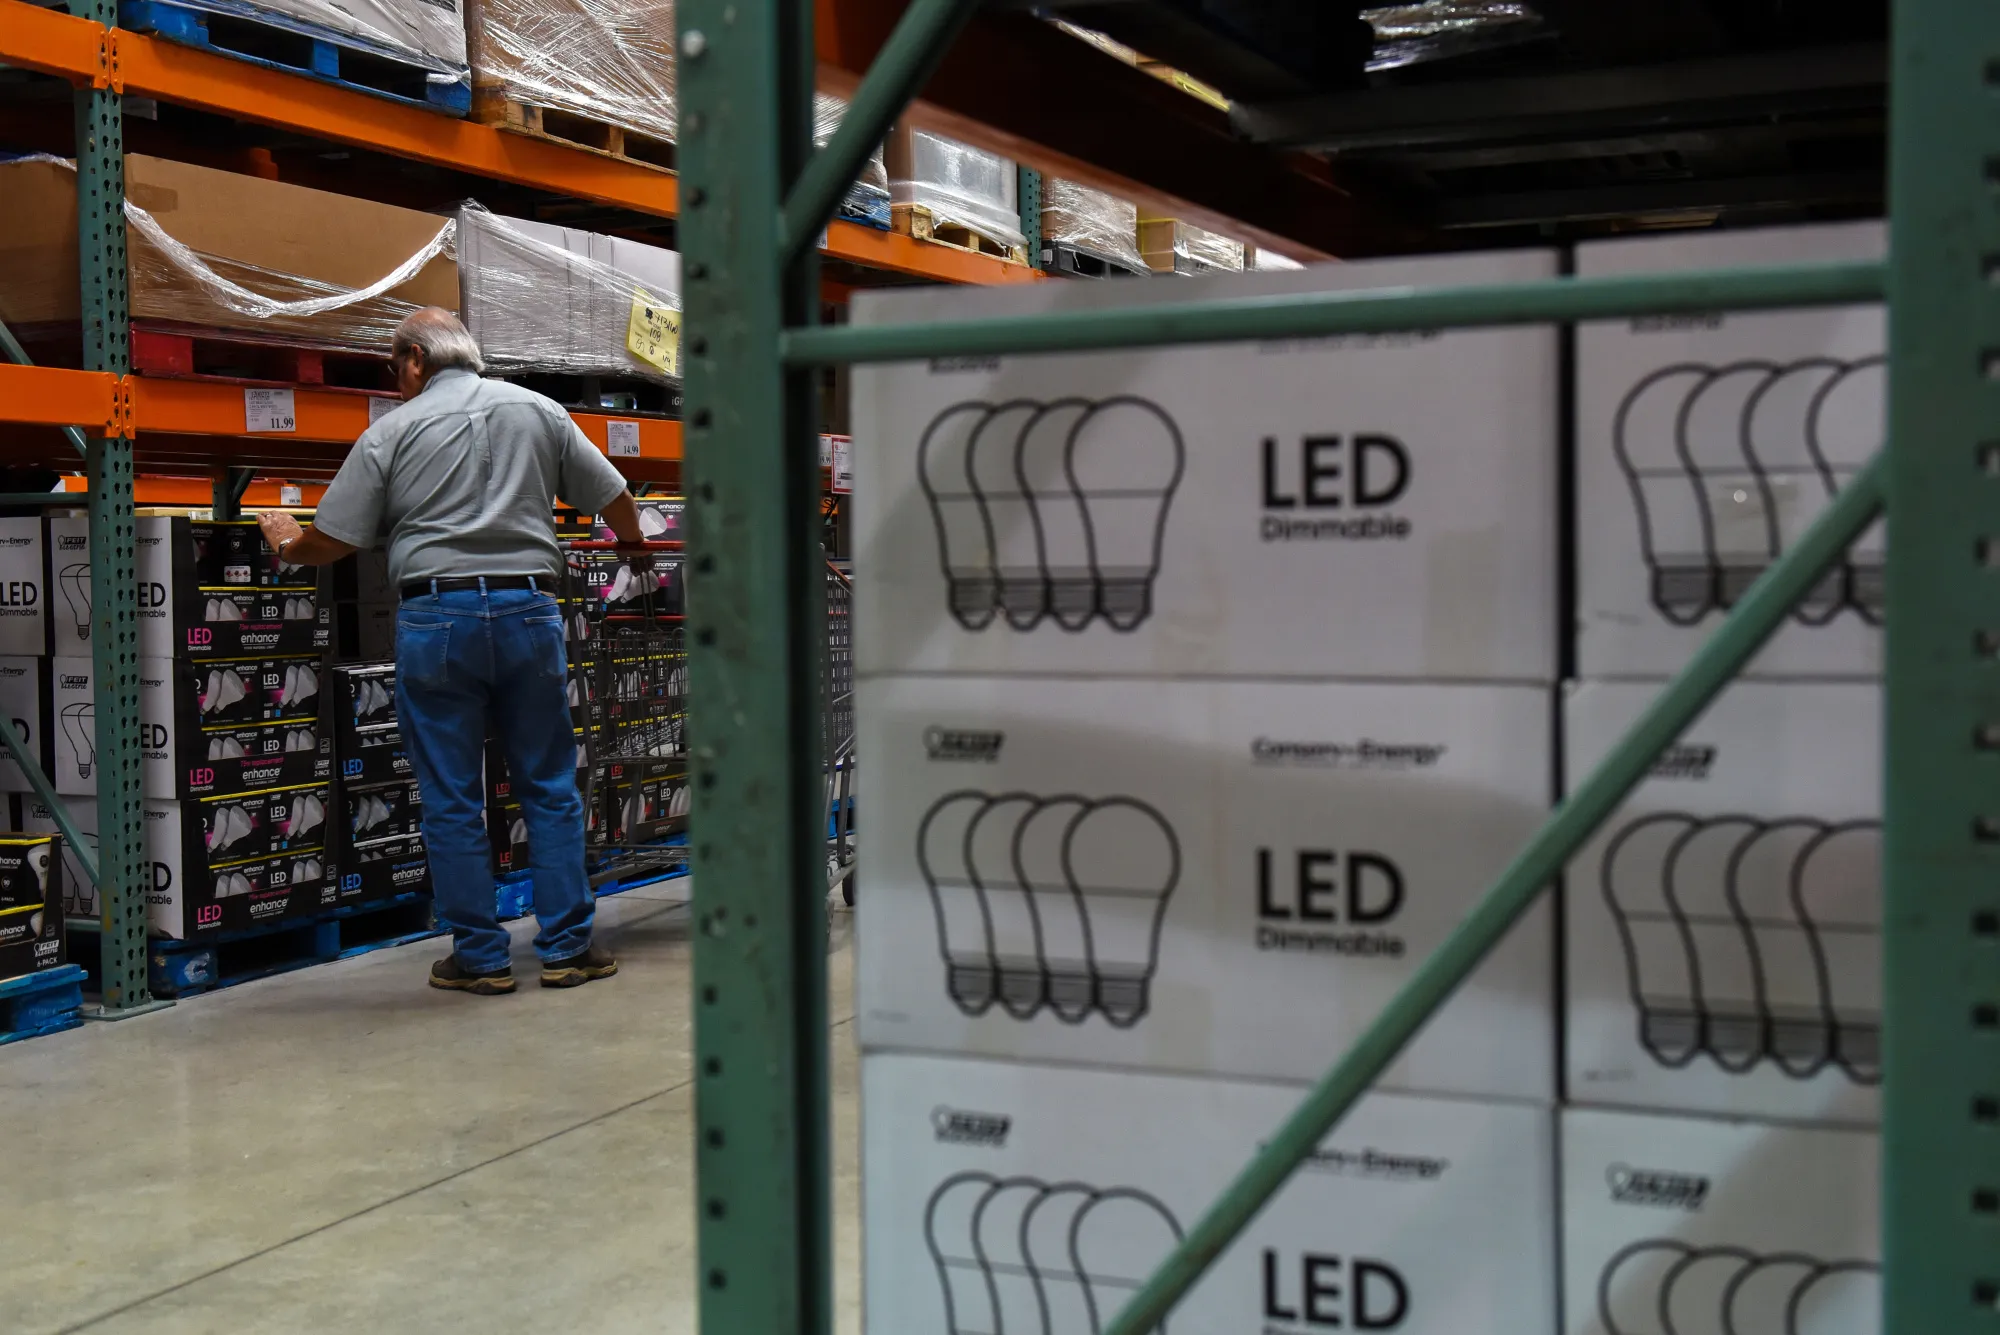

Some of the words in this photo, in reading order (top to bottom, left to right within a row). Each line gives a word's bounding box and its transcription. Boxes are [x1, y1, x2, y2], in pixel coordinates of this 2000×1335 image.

[271, 417, 294, 429] 11.99
[623, 445, 639, 455] 14.99
[1260, 432, 1412, 509] LED
[1260, 514, 1412, 542] Dimmable
[0, 581, 38, 607] LED
[137, 582, 166, 608] ED
[0, 608, 38, 617] Dimmable
[261, 605, 278, 617] LED
[187, 627, 213, 645] LED
[240, 633, 280, 643] enhance
[67, 676, 89, 685] FEIT
[263, 673, 280, 685] LED
[140, 723, 168, 749] ED
[263, 740, 280, 752] LED
[141, 750, 169, 760] mable
[343, 758, 364, 775] LED
[611, 765, 623, 777] LED
[189, 767, 214, 786] LED
[242, 767, 281, 780] enhance
[189, 784, 214, 793] Dimmable
[496, 783, 510, 795] LED
[660, 787, 671, 798] LED
[270, 805, 286, 819] LED
[0, 856, 21, 866] hance
[500, 851, 511, 864] LE
[270, 871, 287, 885] LED
[392, 867, 426, 881] enhance
[341, 873, 362, 892] LED
[1255, 846, 1407, 926] LED
[249, 898, 289, 914] enhance
[197, 904, 222, 924] LED
[197, 920, 222, 931] Dimmable
[1255, 925, 1407, 959] Dimmable
[37, 957, 58, 968] 6-PACK
[1260, 1246, 1412, 1332] LED
